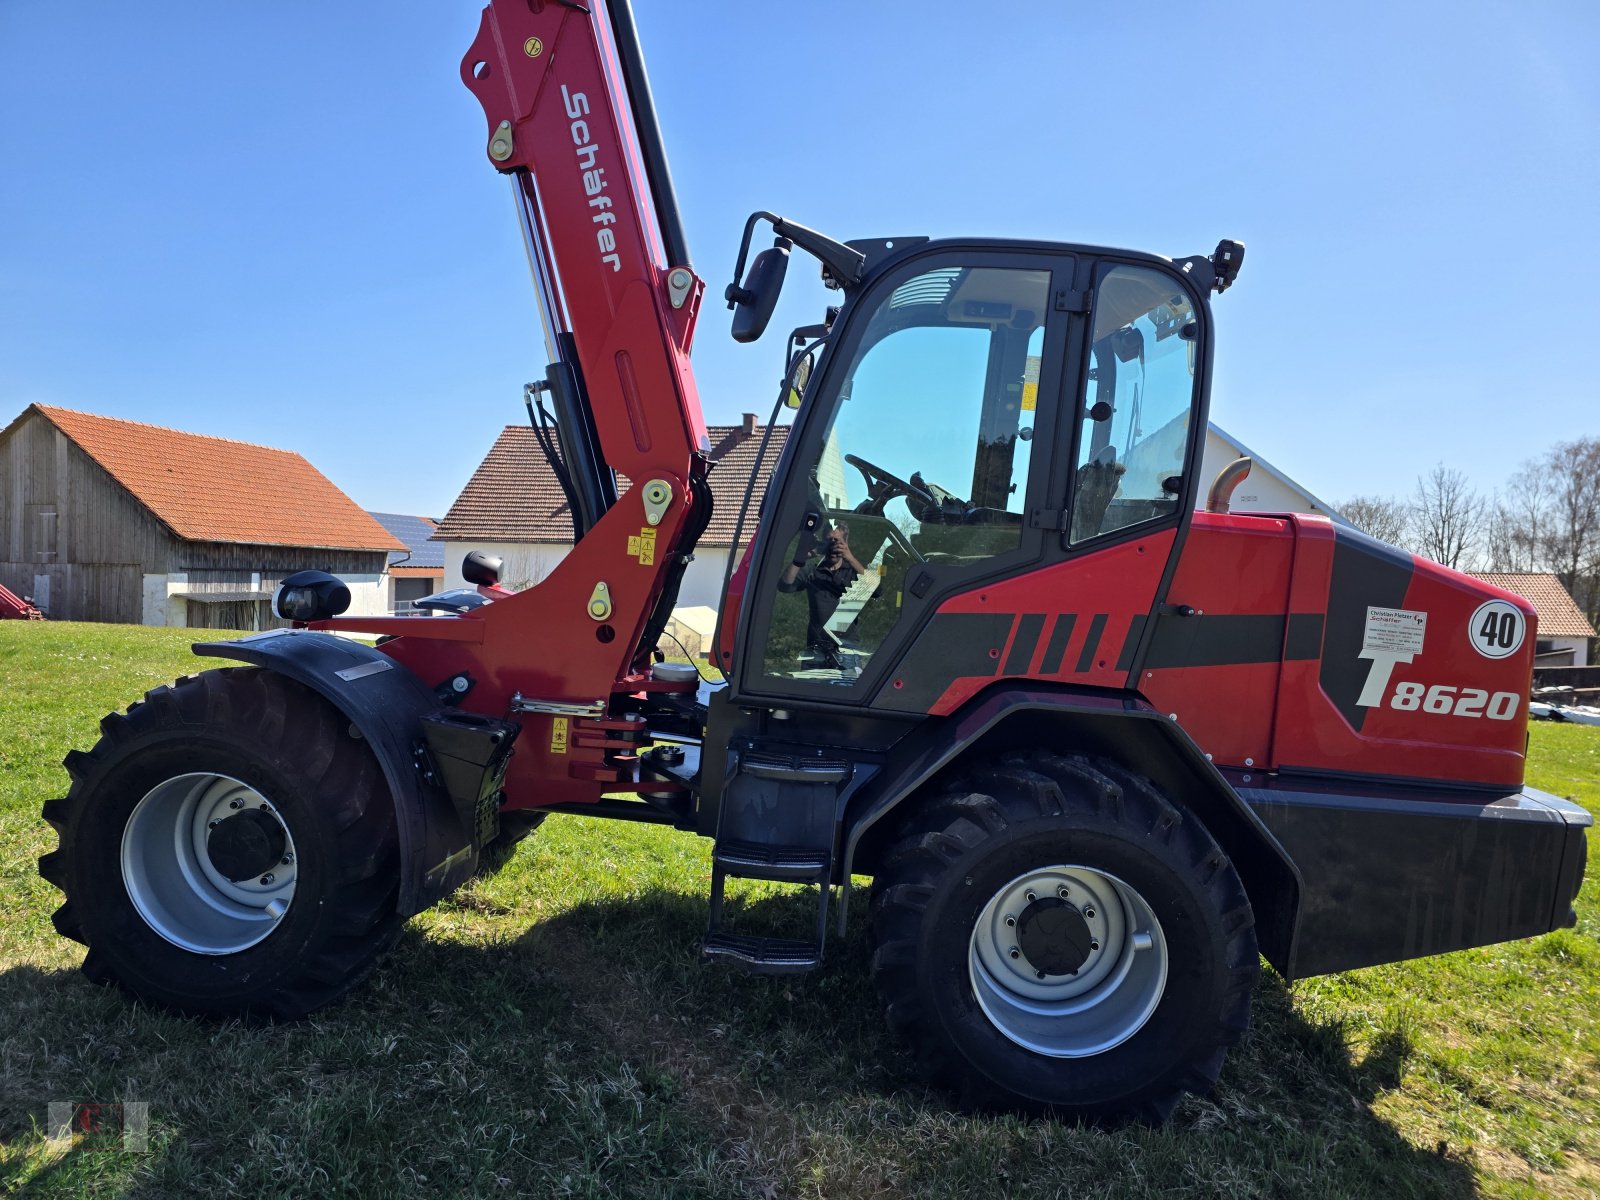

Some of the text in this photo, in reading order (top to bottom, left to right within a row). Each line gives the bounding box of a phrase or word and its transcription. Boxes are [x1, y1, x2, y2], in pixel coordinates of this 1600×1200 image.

[560, 84, 622, 273] Schäffer
[1370, 610, 1394, 618] Christian
[1479, 611, 1516, 649] 40
